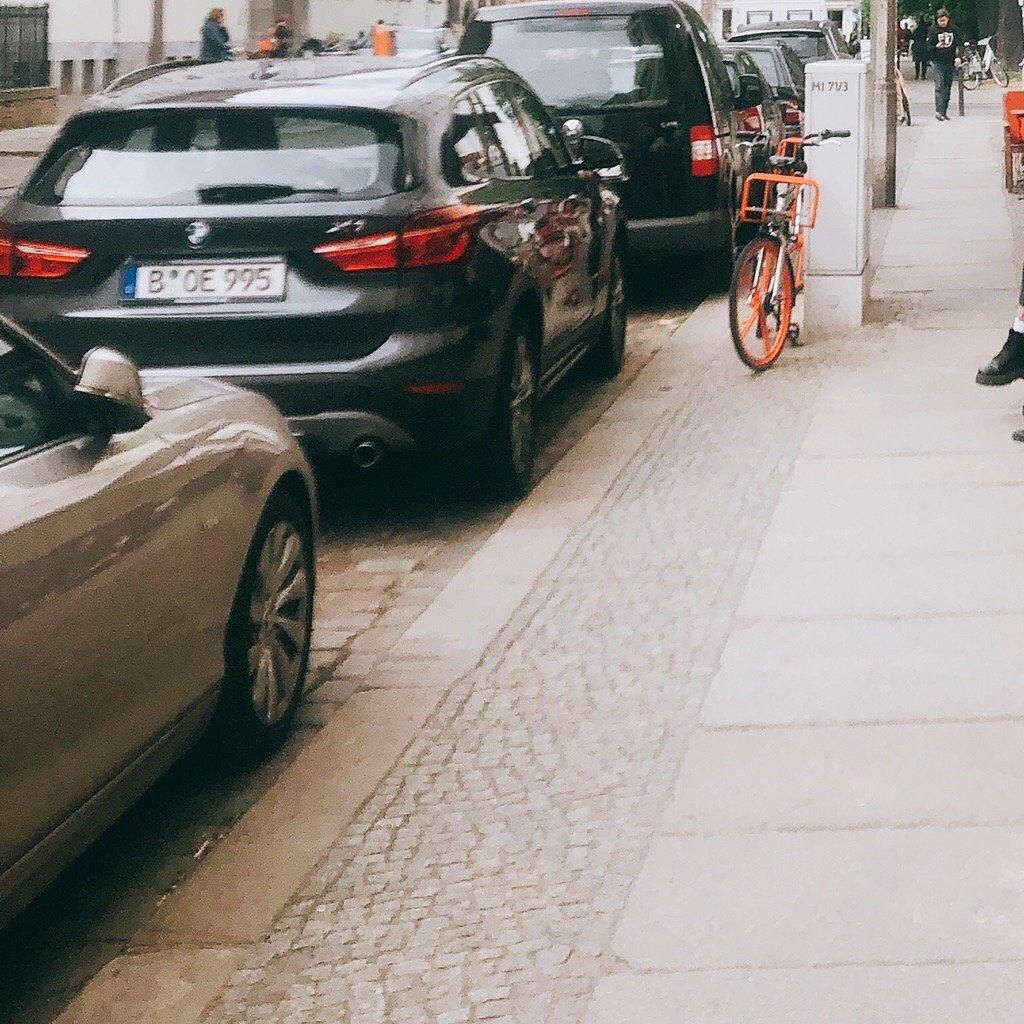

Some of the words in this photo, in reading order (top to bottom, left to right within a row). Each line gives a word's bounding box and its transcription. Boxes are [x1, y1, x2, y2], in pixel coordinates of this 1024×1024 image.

[148, 269, 164, 294] B
[184, 268, 215, 293] OE
[224, 267, 272, 292] 995
